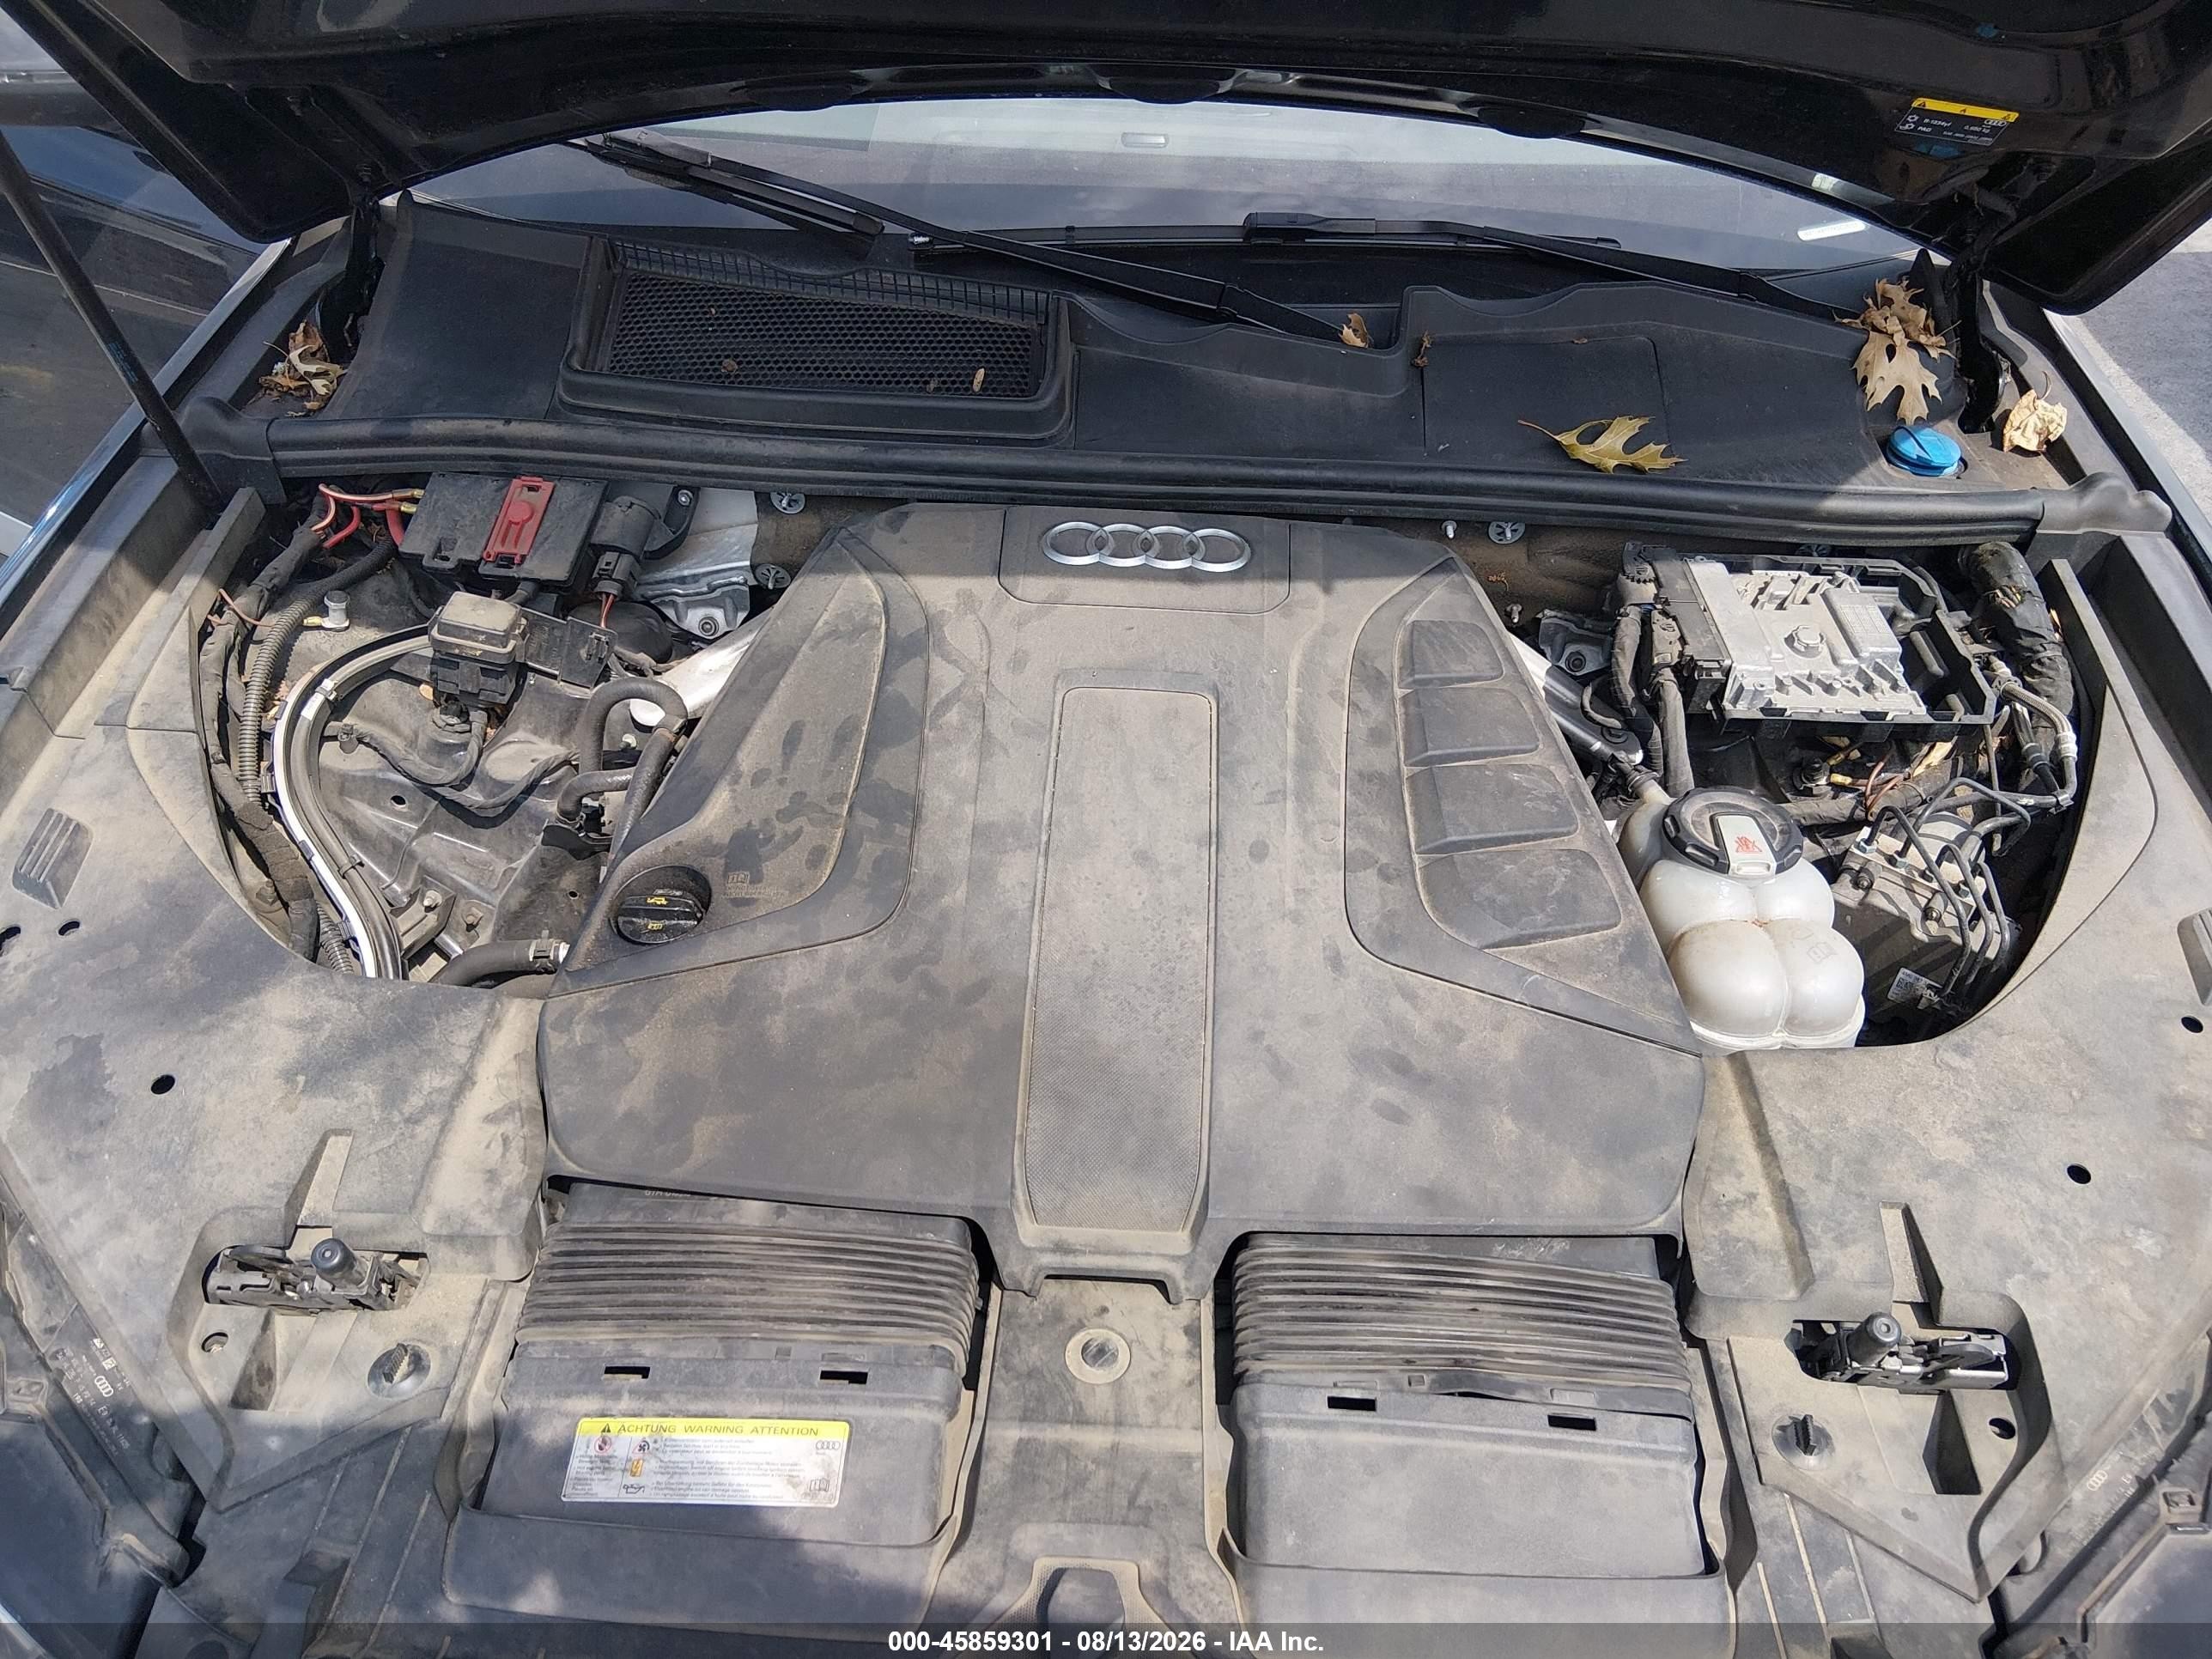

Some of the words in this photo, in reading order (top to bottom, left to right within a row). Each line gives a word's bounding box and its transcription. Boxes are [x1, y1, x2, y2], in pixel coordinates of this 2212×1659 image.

[617, 1424, 677, 1433] ACHTUNG
[684, 1425, 744, 1434] WARNING
[750, 1426, 818, 1436] ATTENTION
